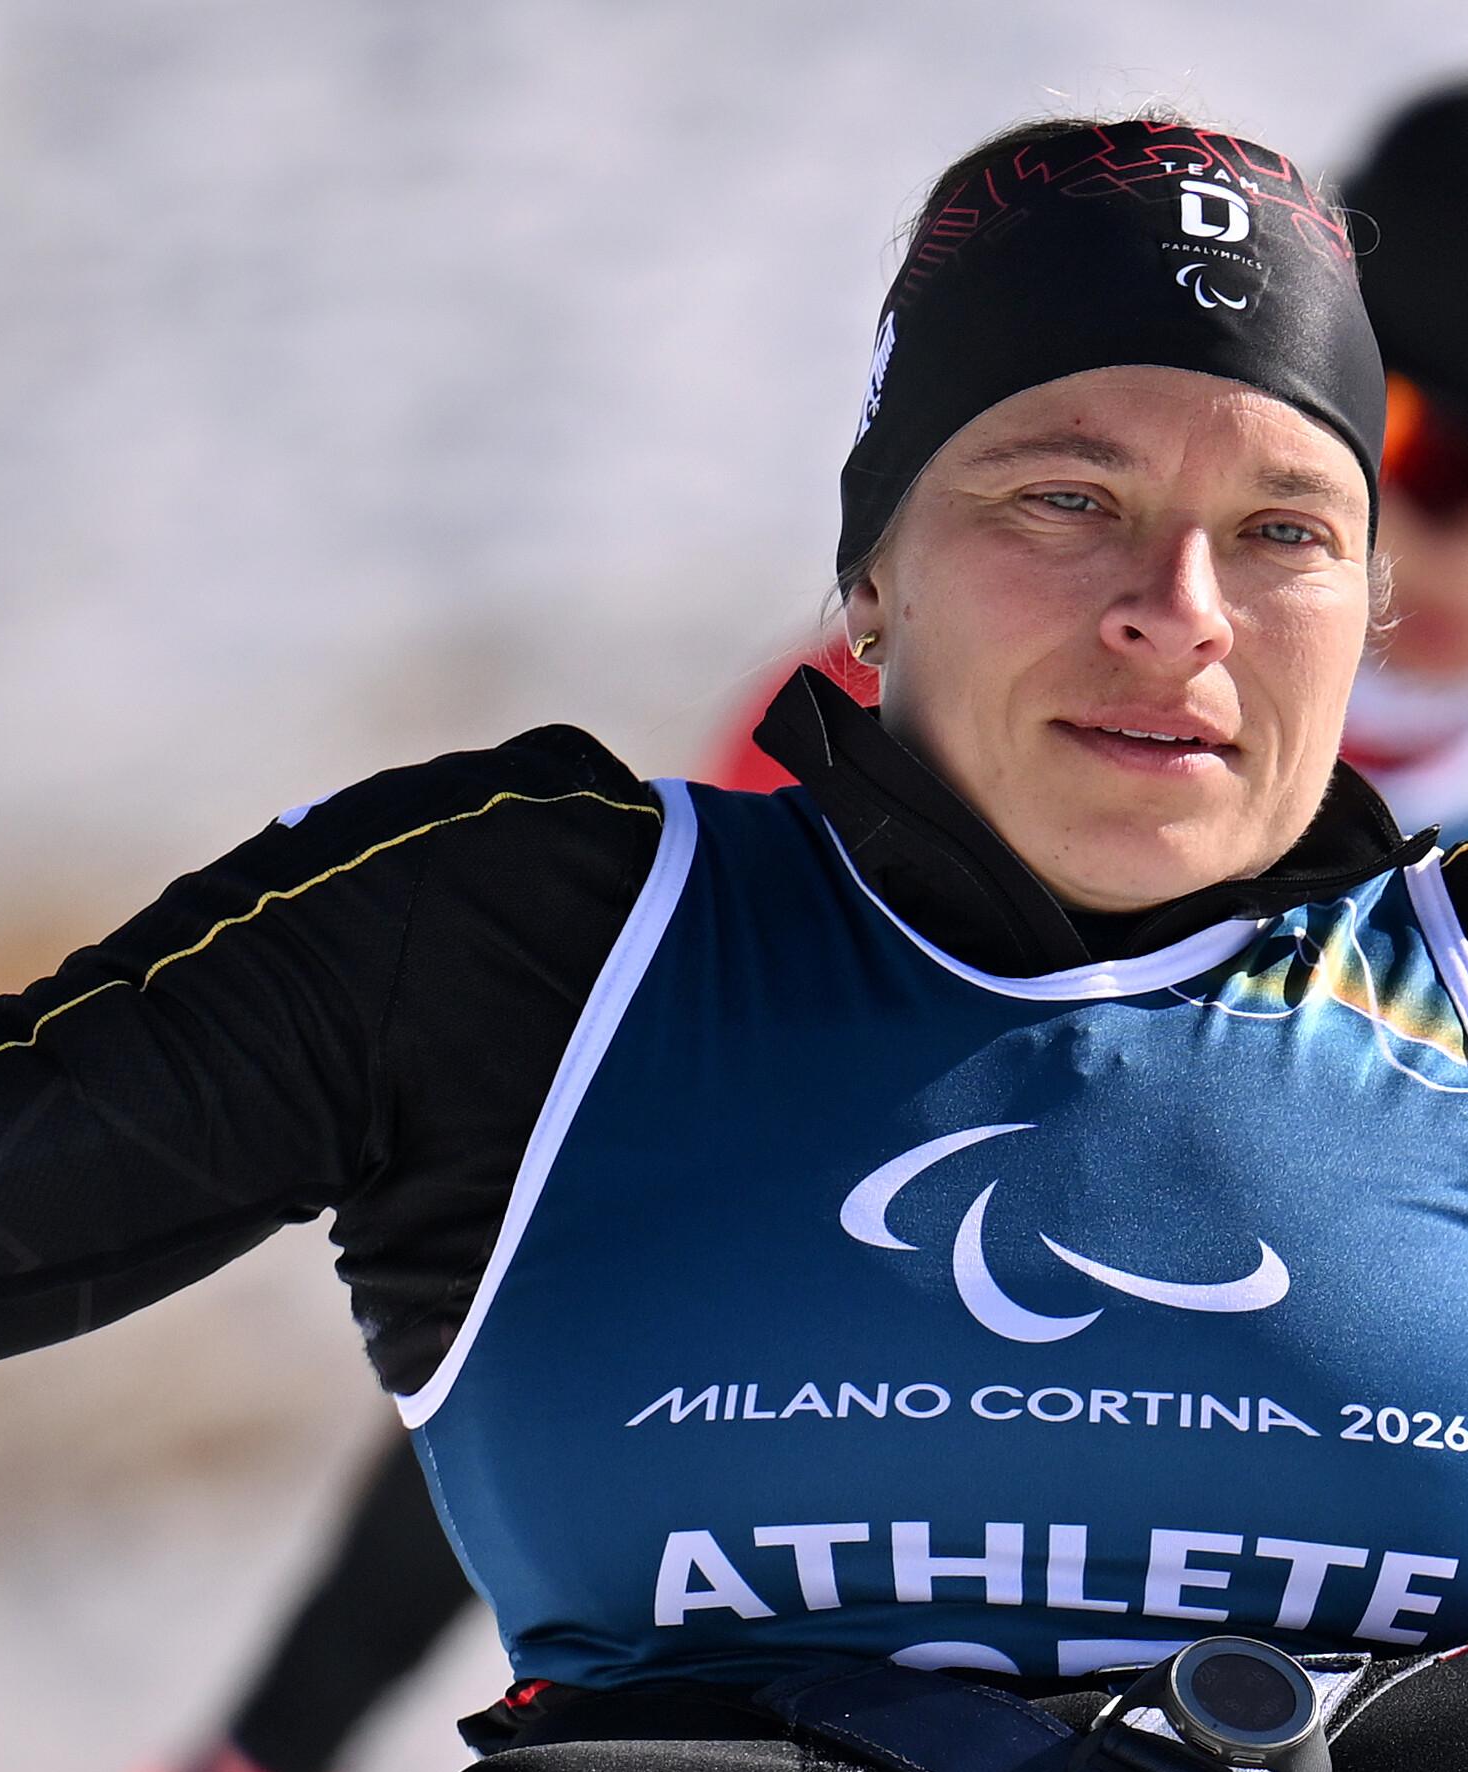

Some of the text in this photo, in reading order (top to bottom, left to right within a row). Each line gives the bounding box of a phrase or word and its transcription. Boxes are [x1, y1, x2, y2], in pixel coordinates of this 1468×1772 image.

[1159, 161, 1260, 195] TEAM
[1161, 242, 1263, 271] PARALYMPICS
[624, 1381, 952, 1428] MILANO
[969, 1384, 1322, 1438] CORTINA
[653, 1520, 1460, 1646] ATHLETE
